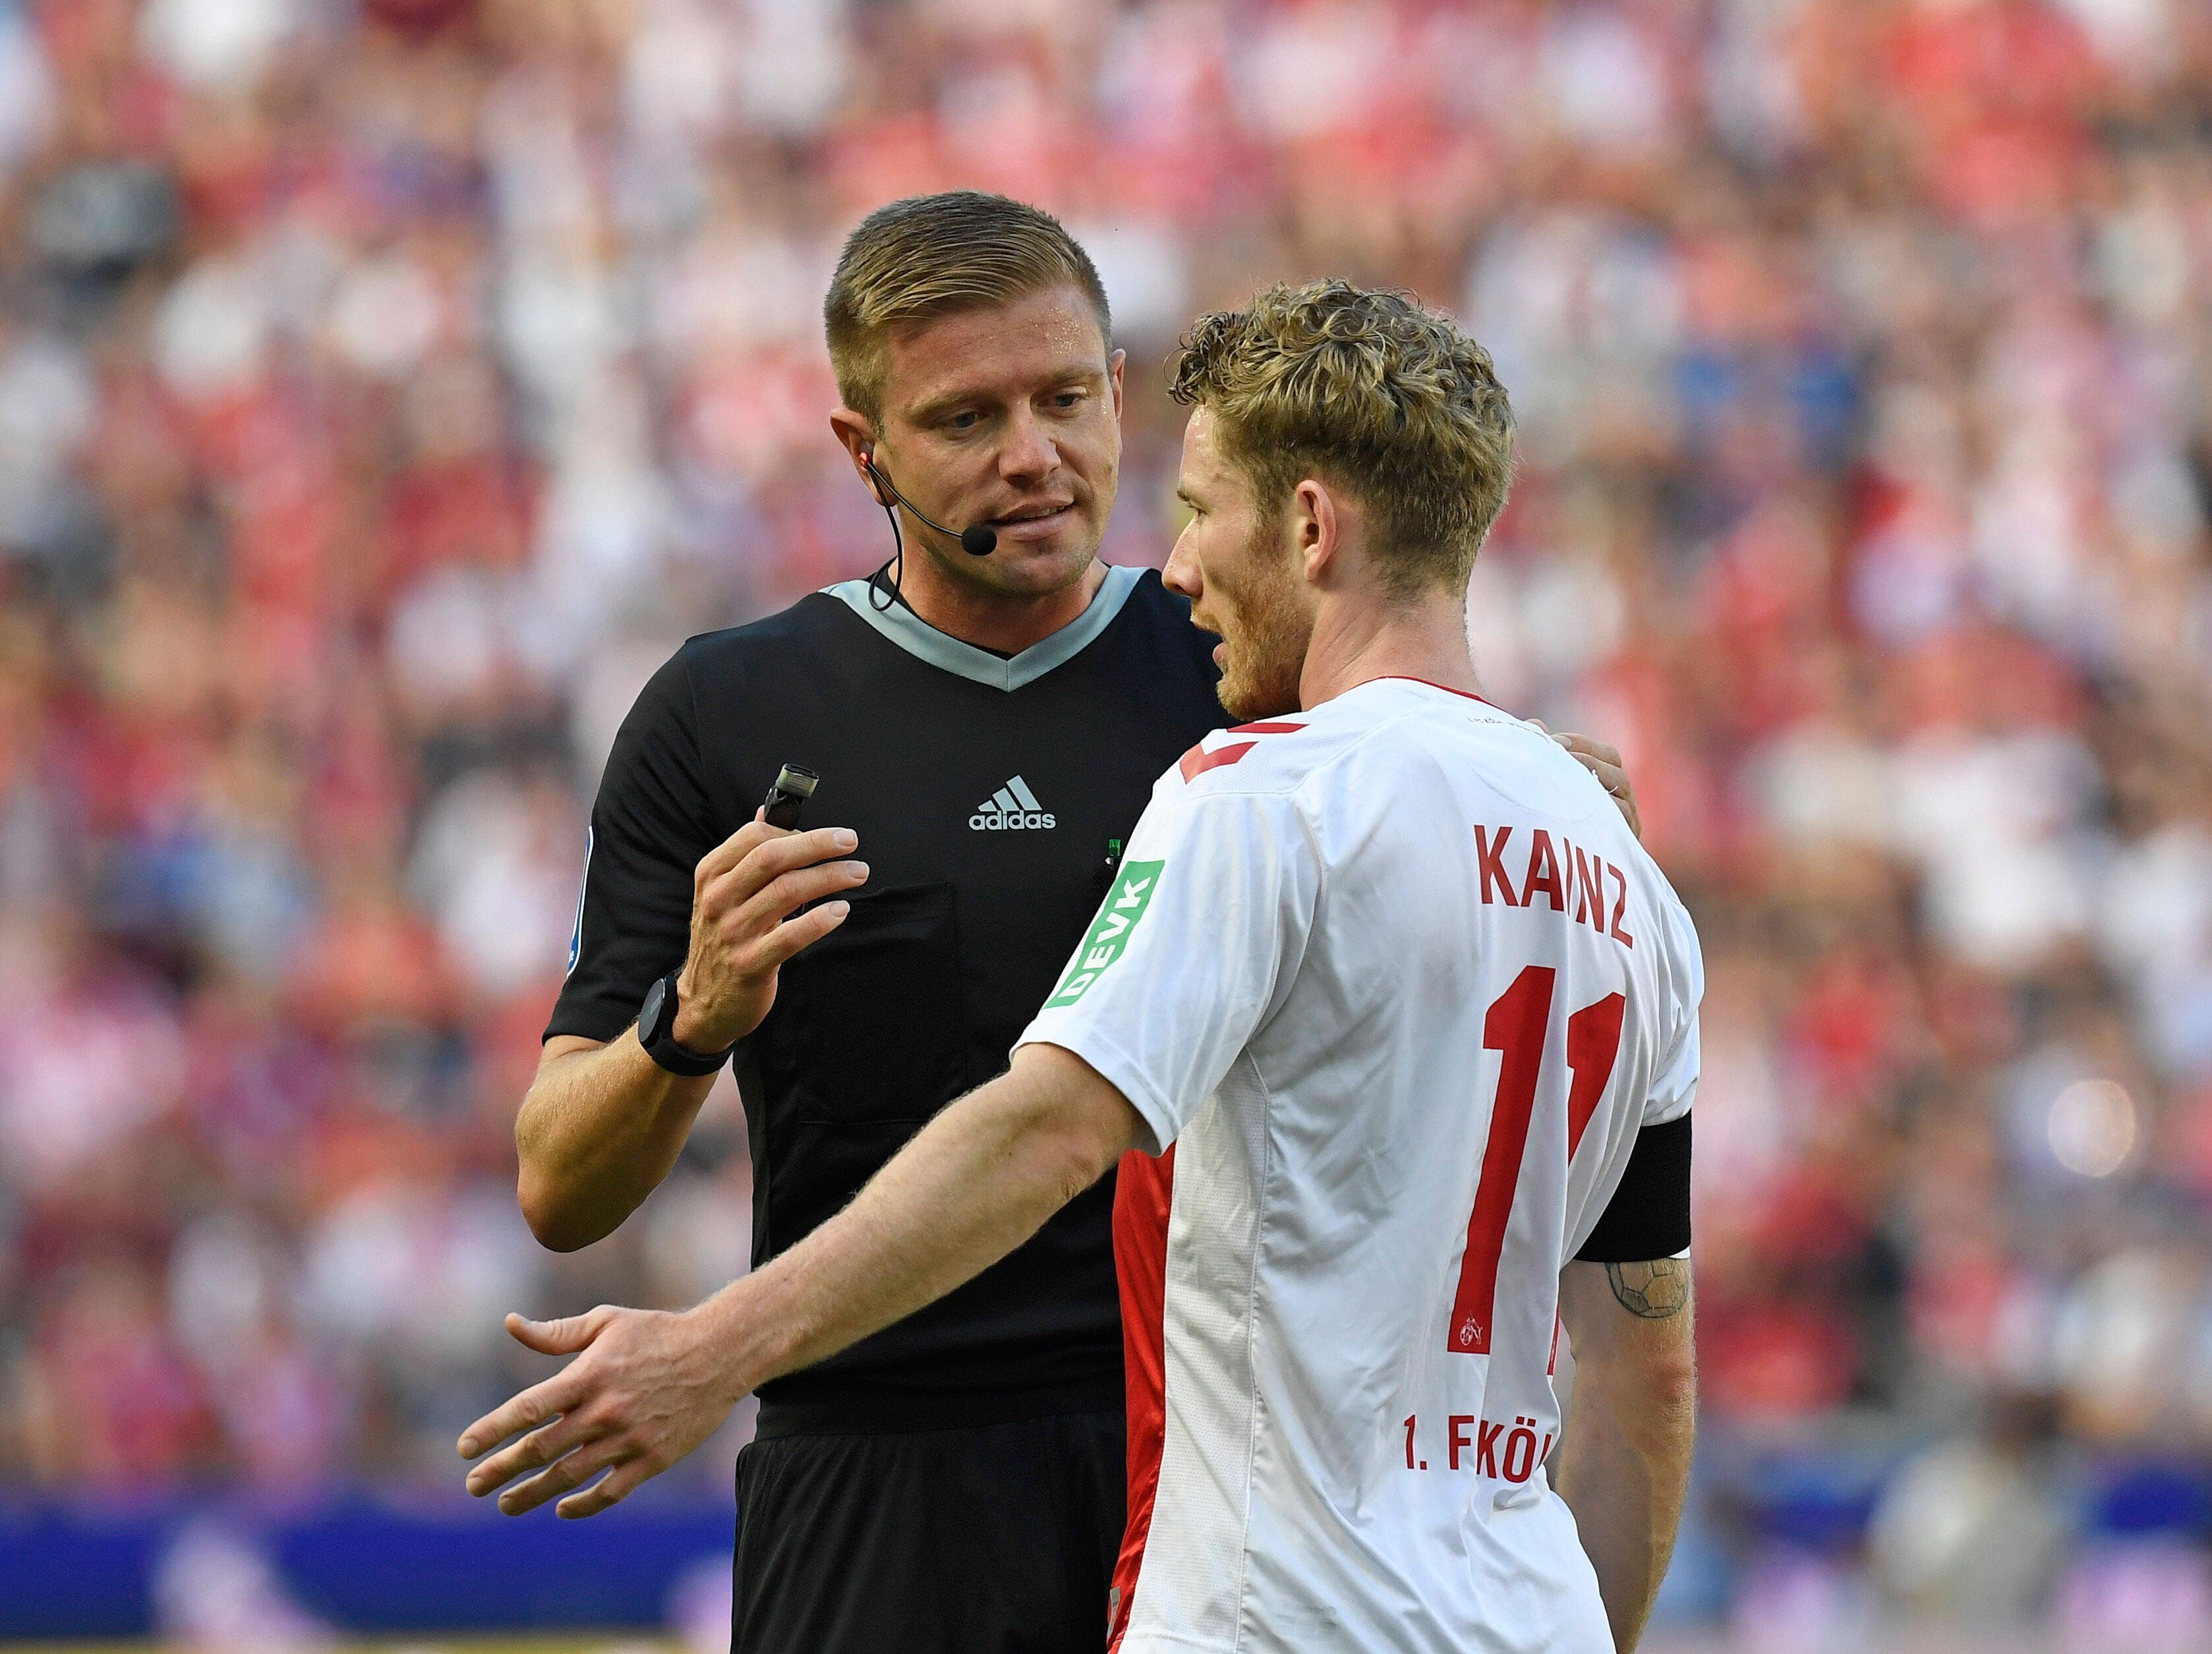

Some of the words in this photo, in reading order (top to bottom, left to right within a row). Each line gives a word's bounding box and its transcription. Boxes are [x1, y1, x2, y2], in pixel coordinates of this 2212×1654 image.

[968, 810, 1057, 830] adidas
[1057, 876, 1151, 998] DEVK
[1473, 824, 1633, 950] KAINZ
[1447, 965, 1625, 1376] 11
[1404, 1414, 1427, 1470] 1.
[1448, 1415, 1475, 1470] F
